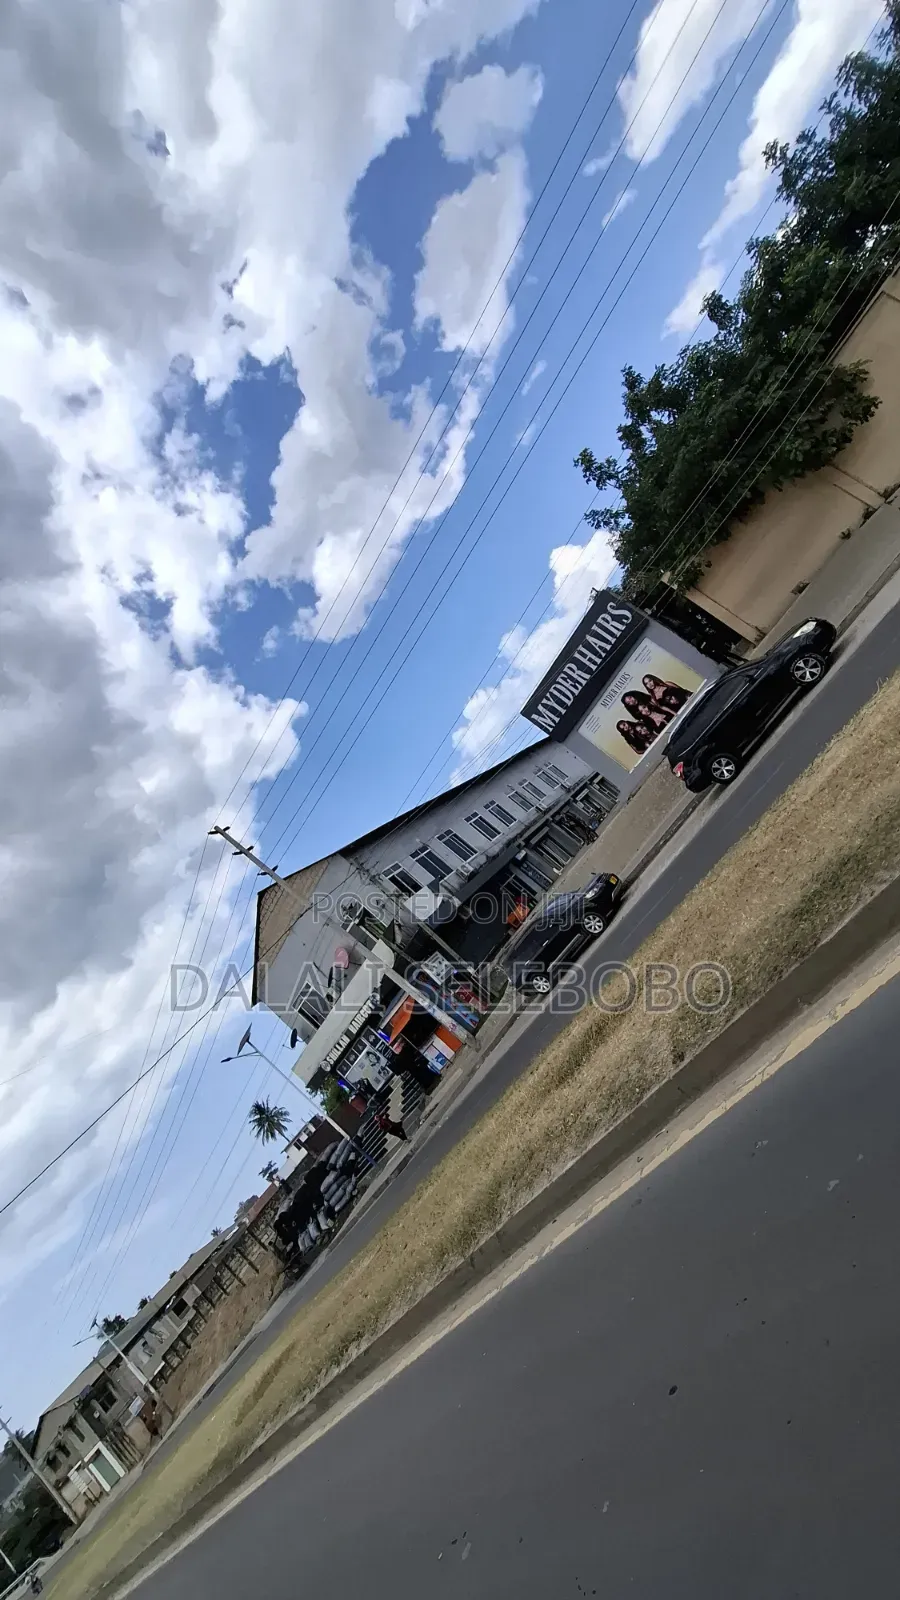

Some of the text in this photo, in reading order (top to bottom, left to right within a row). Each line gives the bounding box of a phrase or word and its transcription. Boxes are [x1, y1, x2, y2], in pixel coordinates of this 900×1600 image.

[531, 662, 591, 732] MYDER
[574, 602, 633, 671] HAIRS
[600, 687, 618, 708] MYDER
[613, 671, 630, 690] HAIRS
